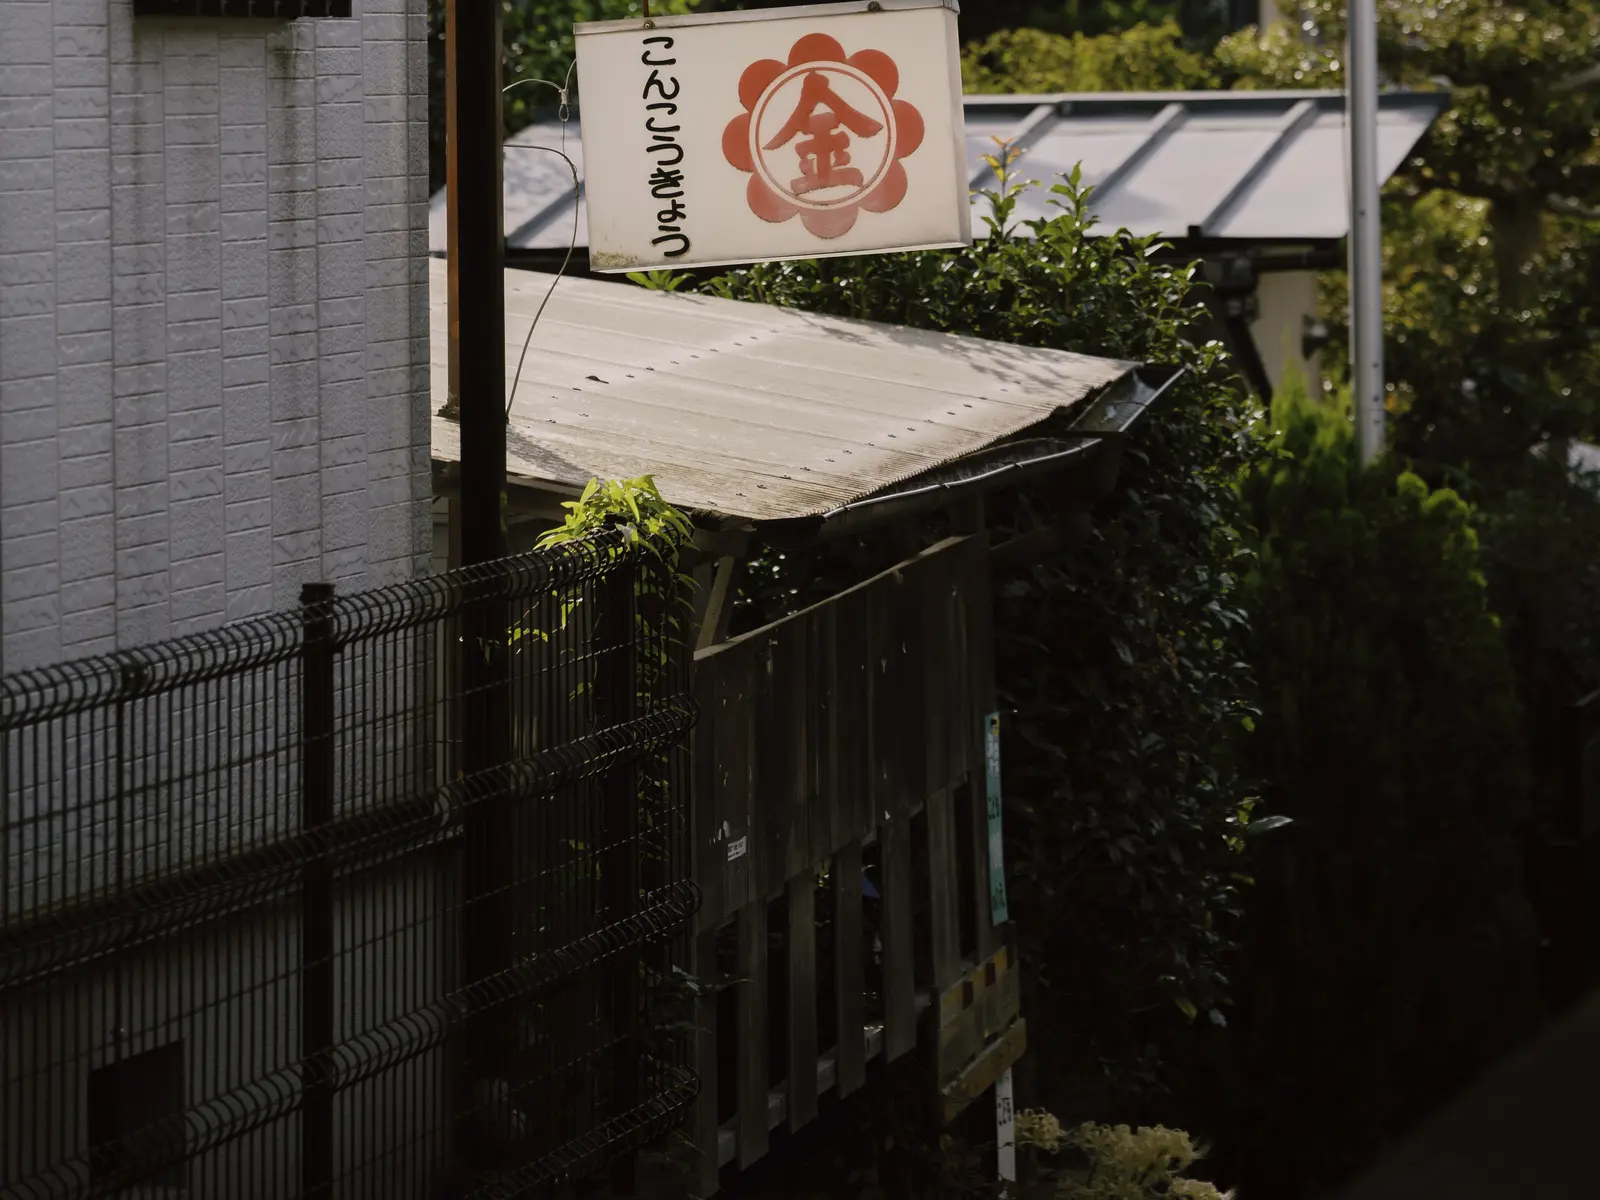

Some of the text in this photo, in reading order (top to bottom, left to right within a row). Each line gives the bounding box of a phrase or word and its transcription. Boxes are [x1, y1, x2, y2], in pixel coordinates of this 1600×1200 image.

[641, 35, 691, 259] こんこうきょう
